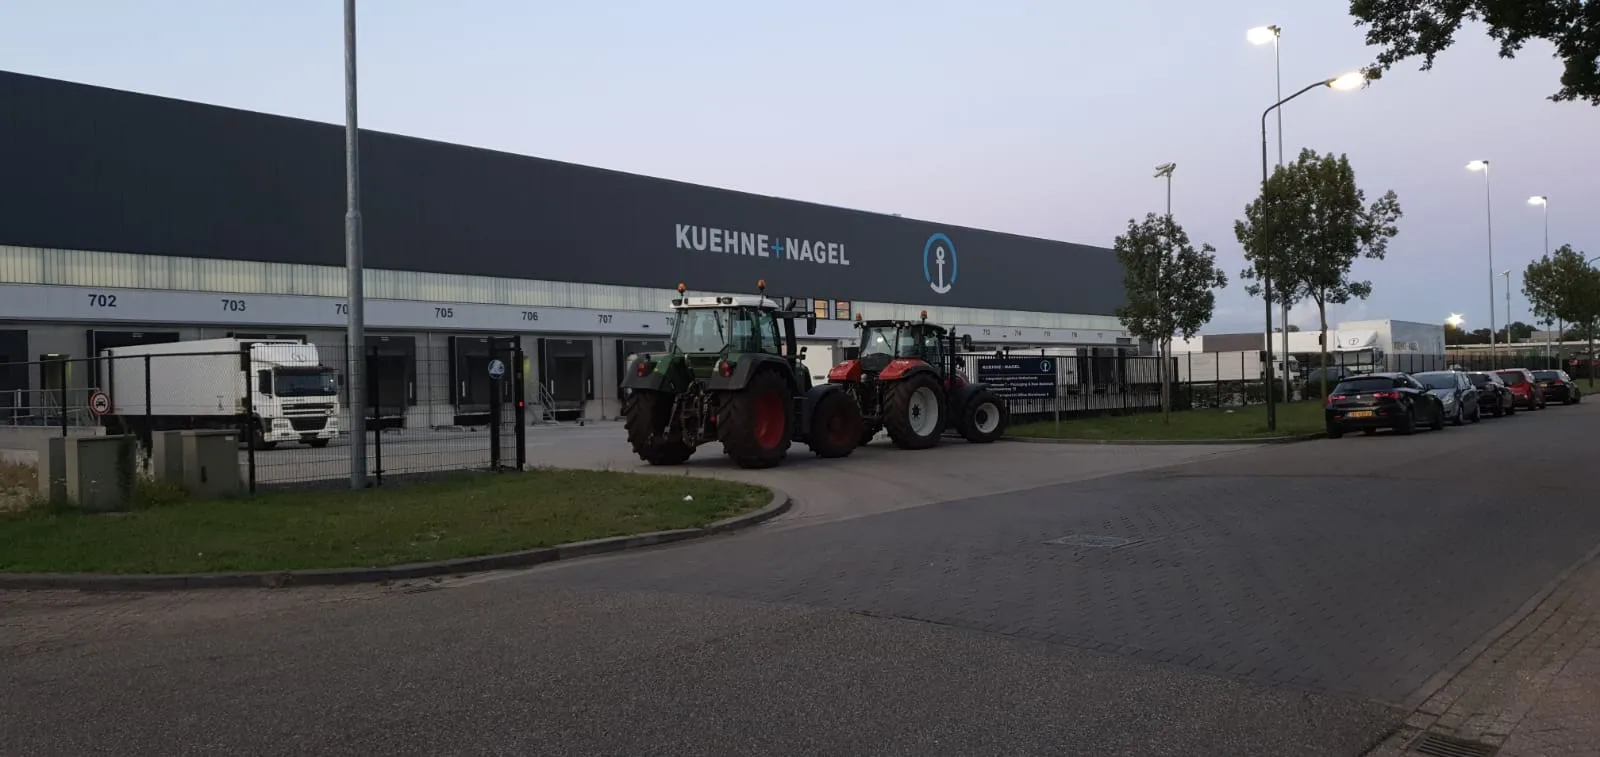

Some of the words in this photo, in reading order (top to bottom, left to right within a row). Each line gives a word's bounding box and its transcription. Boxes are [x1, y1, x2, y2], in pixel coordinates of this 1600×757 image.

[88, 293, 117, 308] 702
[221, 299, 247, 312] 703
[335, 303, 348, 315] 70
[434, 307, 454, 319] 705
[521, 311, 539, 321] 706
[598, 314, 613, 324] 707
